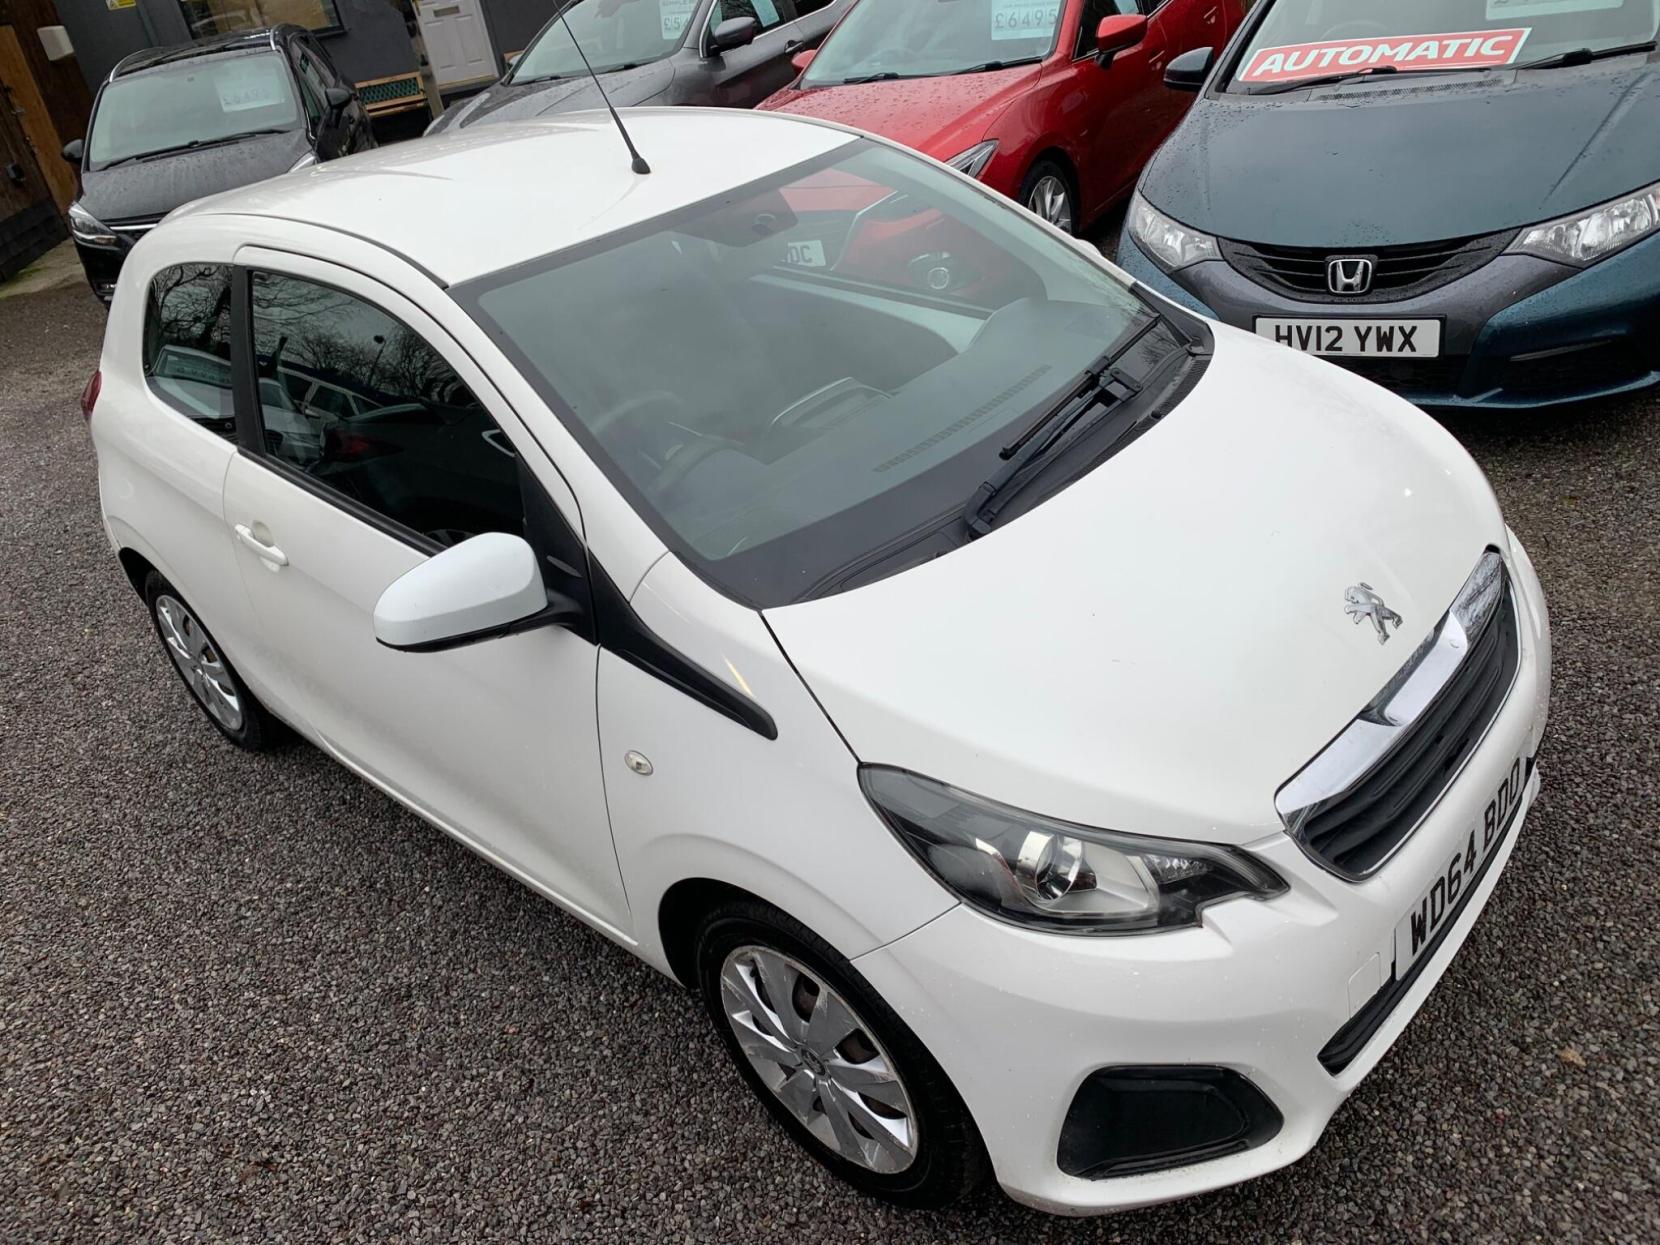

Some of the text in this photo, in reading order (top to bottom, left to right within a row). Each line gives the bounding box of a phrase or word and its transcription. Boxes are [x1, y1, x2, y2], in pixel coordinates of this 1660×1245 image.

[994, 9, 1057, 29] £6495
[1251, 35, 1513, 77] AUTOMATIC
[1274, 325, 1417, 352] HV12 YWX
[1410, 829, 1477, 956] WD64
